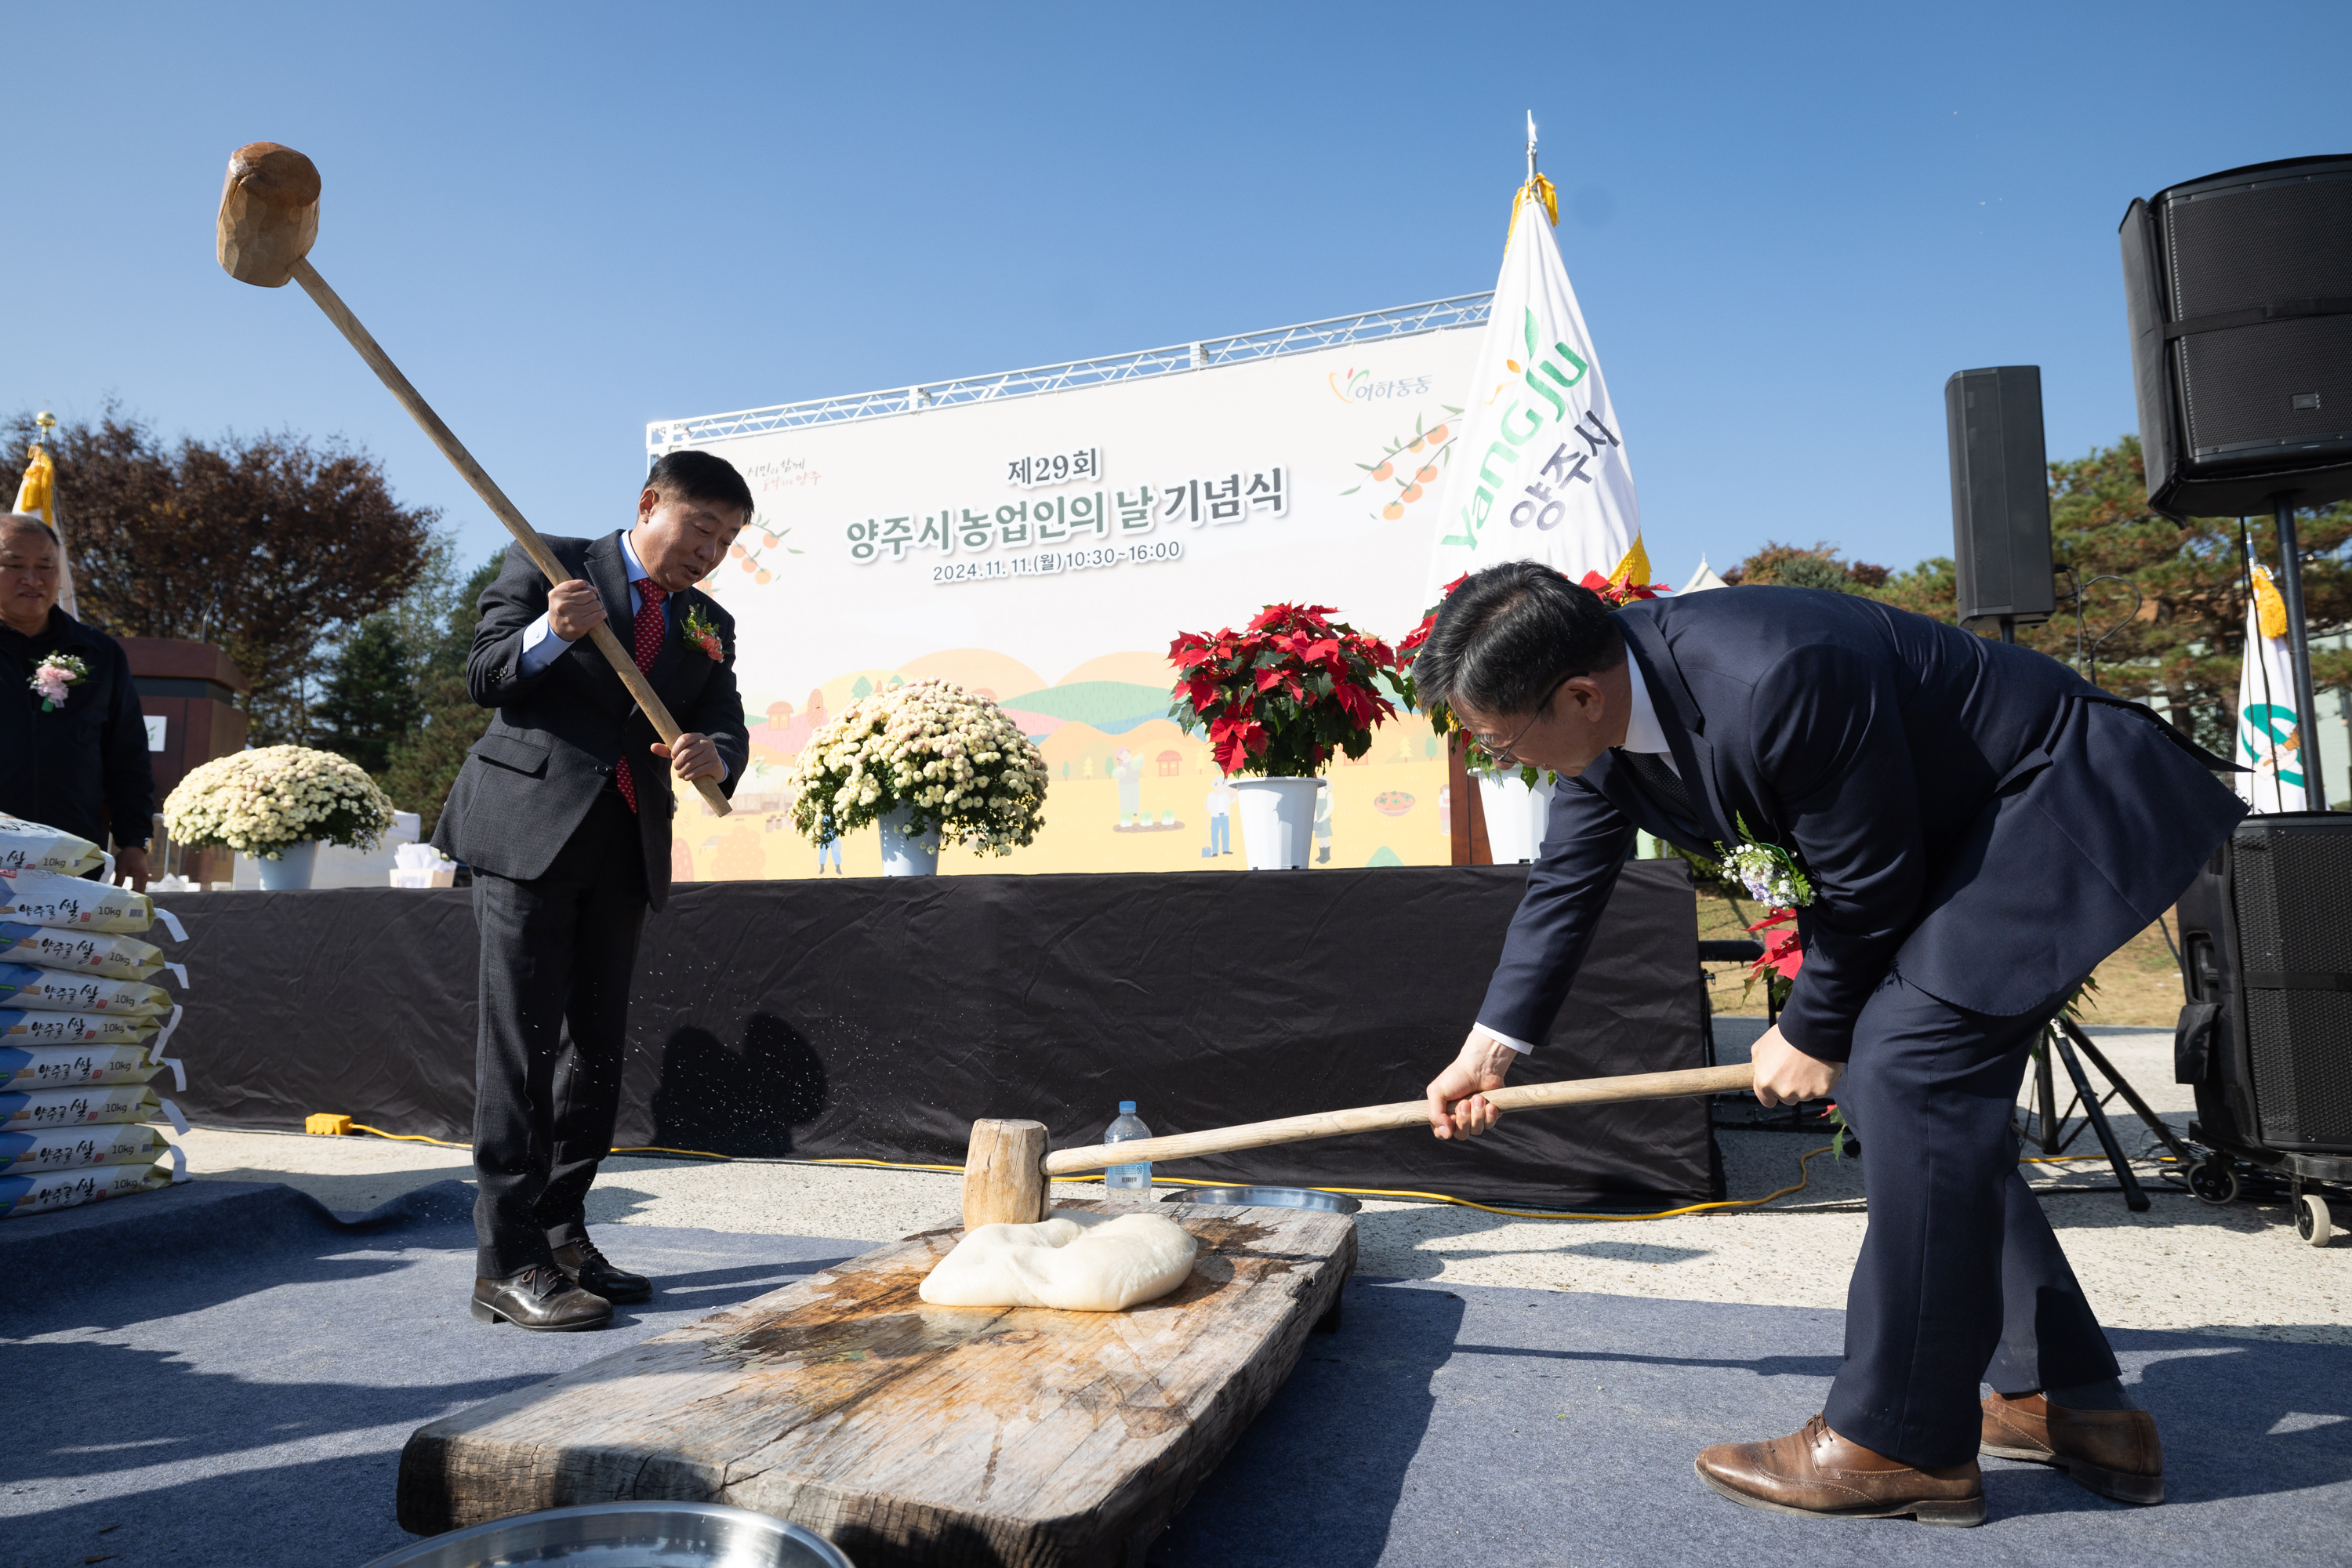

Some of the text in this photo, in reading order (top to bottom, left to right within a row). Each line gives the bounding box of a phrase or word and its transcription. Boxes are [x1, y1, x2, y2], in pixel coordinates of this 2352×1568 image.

[1355, 375, 1433, 401] 어하둥둥
[780, 457, 805, 473] 함께
[1007, 447, 1097, 485] 제29회
[1509, 409, 1621, 532] 양주시
[796, 471, 822, 485] 양주
[846, 466, 1282, 559] 양주시 농업인의 날 기념식
[43, 858, 66, 869] 10kg
[98, 906, 122, 917] 10kg
[109, 953, 131, 965] 10kg
[114, 995, 135, 1007] 10kg
[103, 1023, 125, 1034] 10kg
[110, 1062, 131, 1072] 10kg
[105, 1103, 127, 1113] 10kg
[112, 1145, 134, 1155] 10kg
[114, 1179, 137, 1190] 10kg
